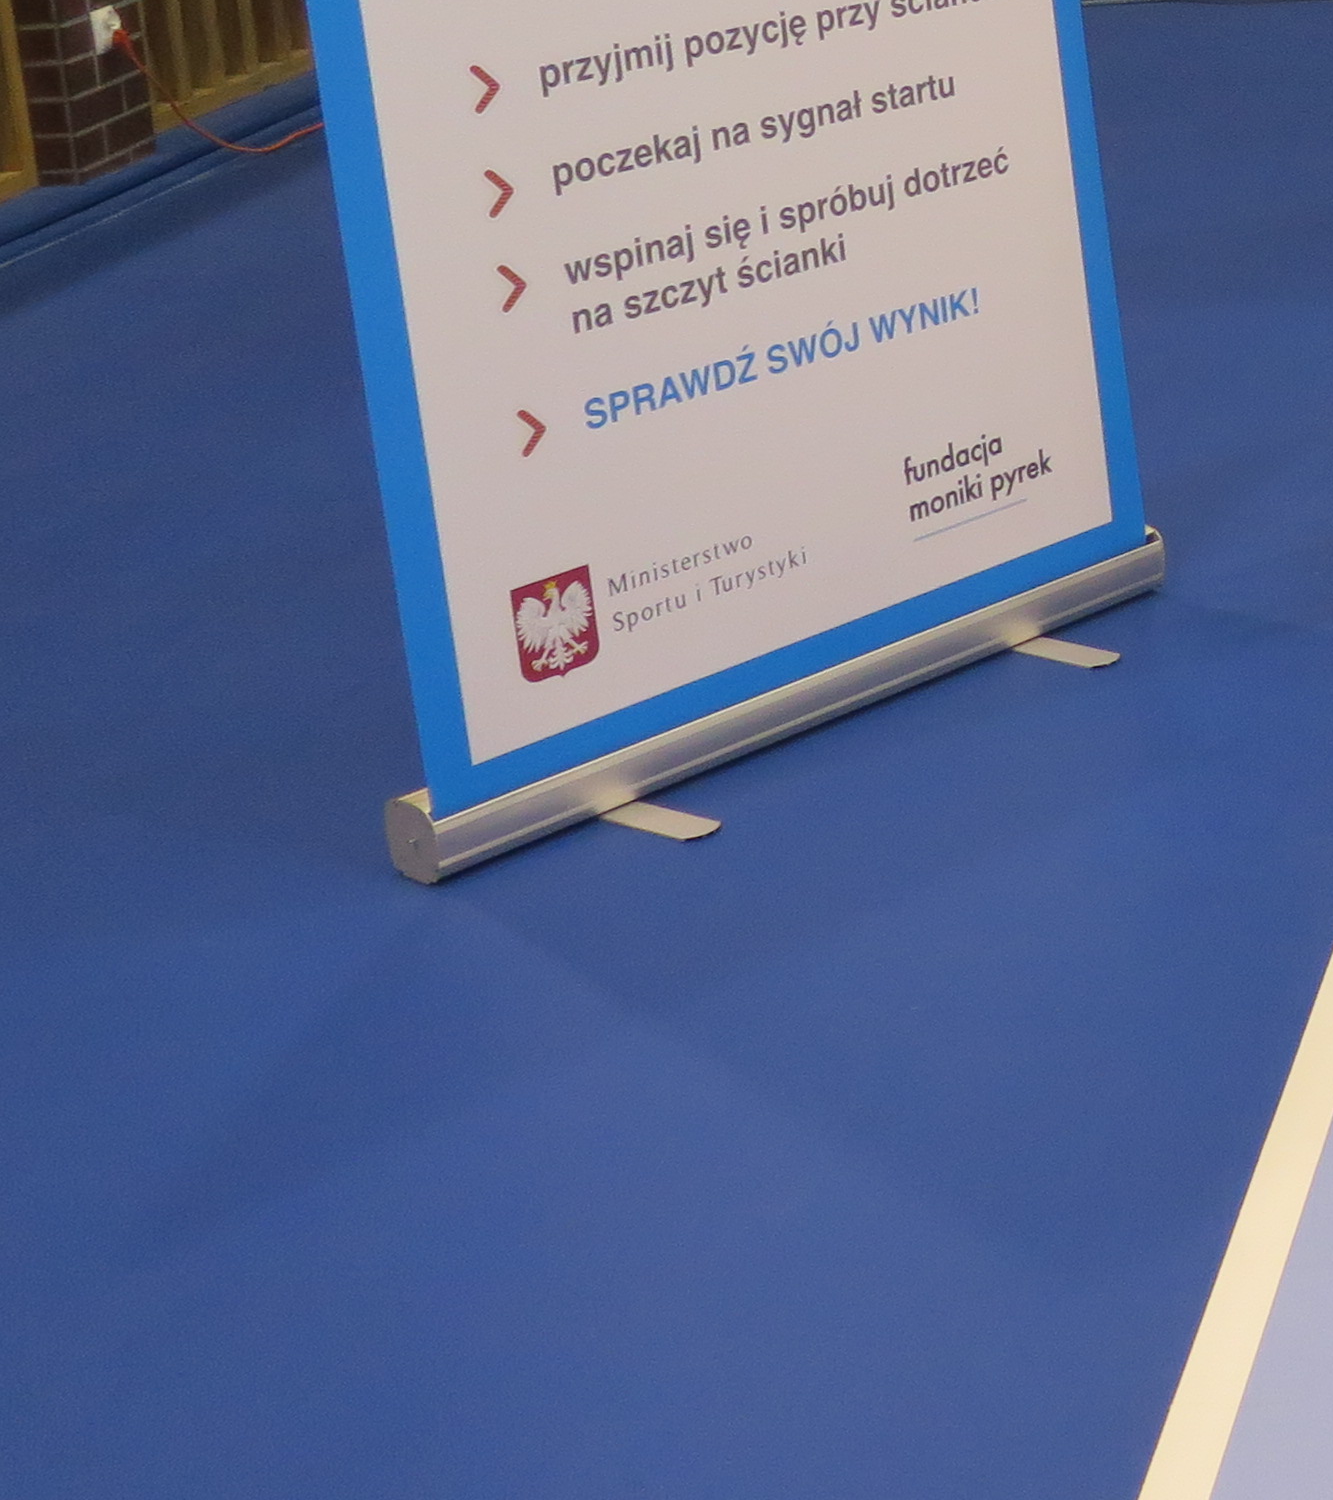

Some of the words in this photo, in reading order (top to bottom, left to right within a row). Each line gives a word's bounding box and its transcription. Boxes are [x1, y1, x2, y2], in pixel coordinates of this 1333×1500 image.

[538, 32, 675, 98] przyjmij
[683, 11, 808, 69] pozycję
[815, 0, 880, 41] przy
[552, 125, 702, 197] poczekaj
[709, 122, 752, 151] na
[759, 89, 863, 144] sygnał
[870, 74, 956, 115] startu
[563, 224, 695, 285] wspinaj
[704, 214, 752, 250] się
[760, 205, 769, 235] i
[778, 173, 896, 234] spróbuj
[903, 146, 1010, 198] dotrzeć
[571, 302, 614, 335] na
[623, 265, 729, 320] szczyt
[736, 232, 847, 289] ścianki
[583, 345, 759, 430] SPRAWDŹ
[766, 319, 860, 375] SWÓJ
[867, 287, 981, 344] WYNIK!
[903, 433, 1003, 486] fundacja
[908, 472, 984, 523] moniki
[989, 448, 1053, 503] pyrek
[607, 535, 753, 597] Ministerstwo
[612, 593, 687, 633] Sportu
[695, 584, 702, 602] i
[708, 545, 808, 596] Turystyki
